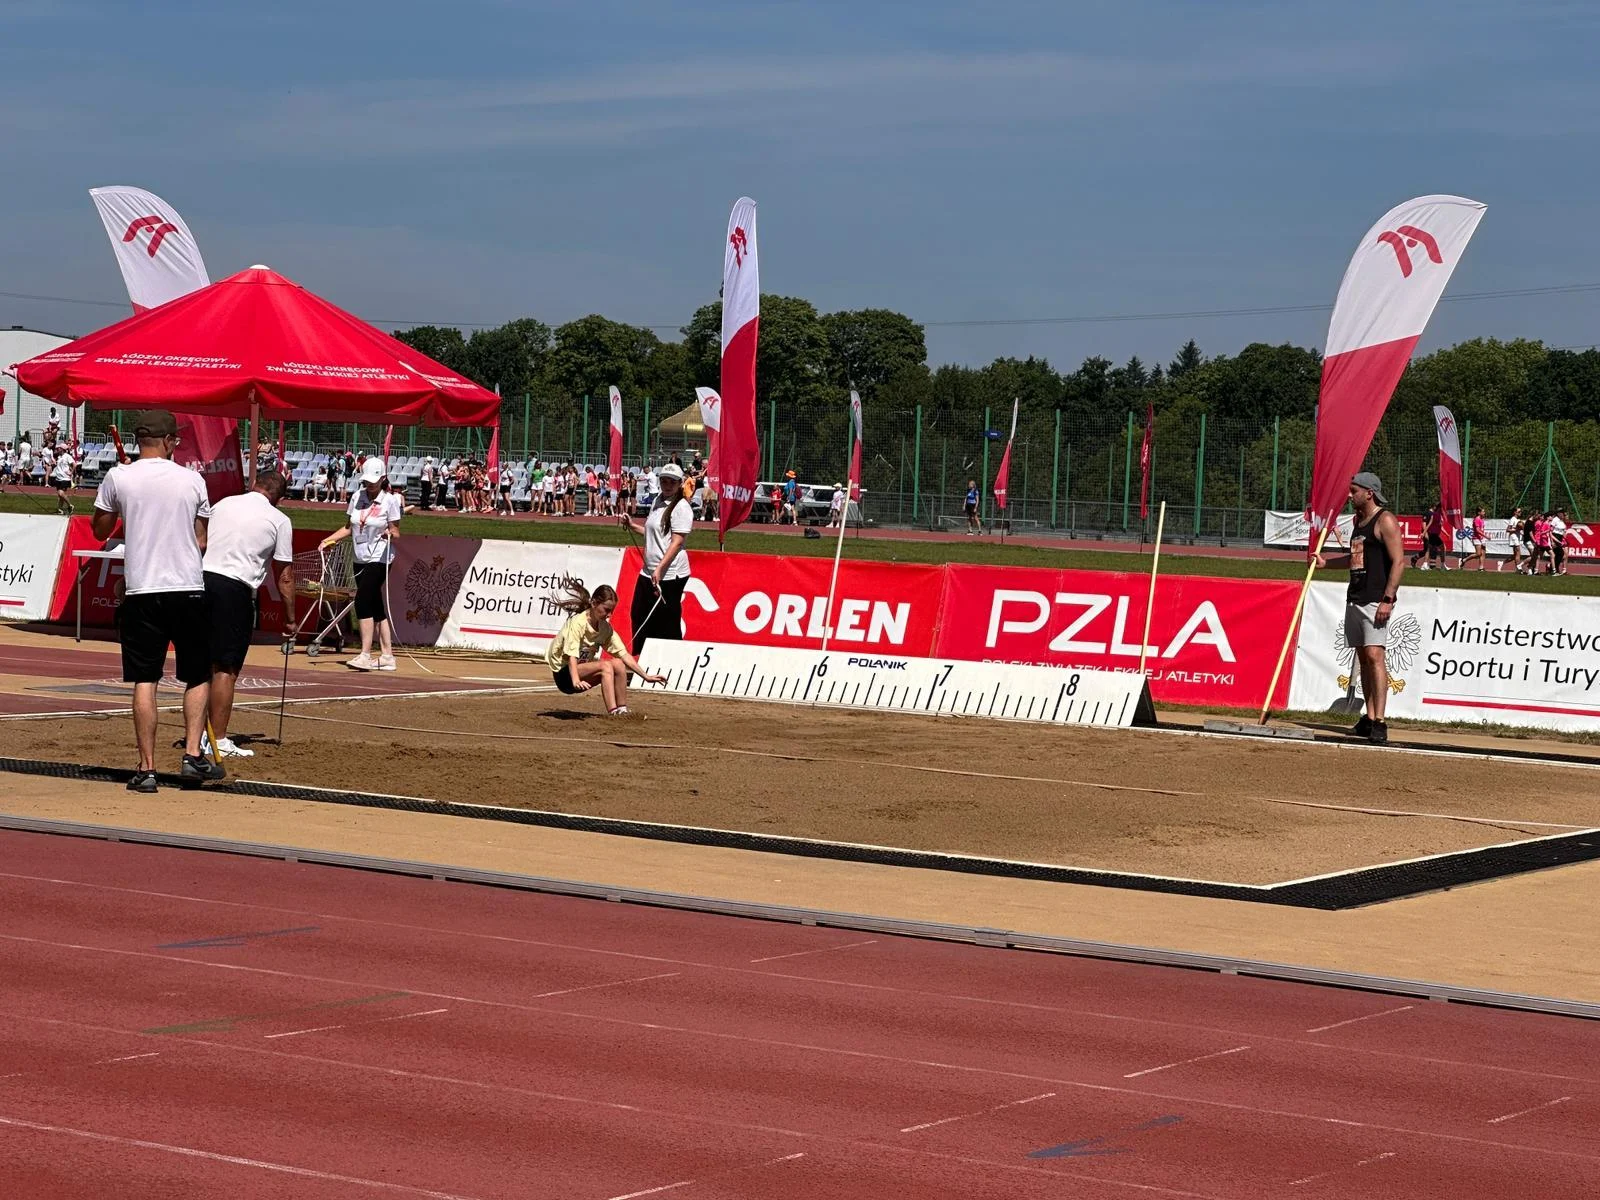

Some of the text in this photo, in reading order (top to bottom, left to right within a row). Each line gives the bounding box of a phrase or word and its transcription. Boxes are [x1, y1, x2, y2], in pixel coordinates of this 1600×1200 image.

[316, 370, 359, 378] LEKKIEJ
[1562, 547, 1596, 557] RLEN
[463, 592, 523, 614] Sportu
[527, 596, 534, 615] i
[733, 590, 911, 645] ORLEN
[985, 589, 1237, 663] PZLA
[700, 647, 1080, 697] 5 6 7 8
[848, 657, 908, 671] POLANIK
[1425, 652, 1600, 691] Sportu i Tury
[1165, 670, 1235, 685] ATLETYKI
